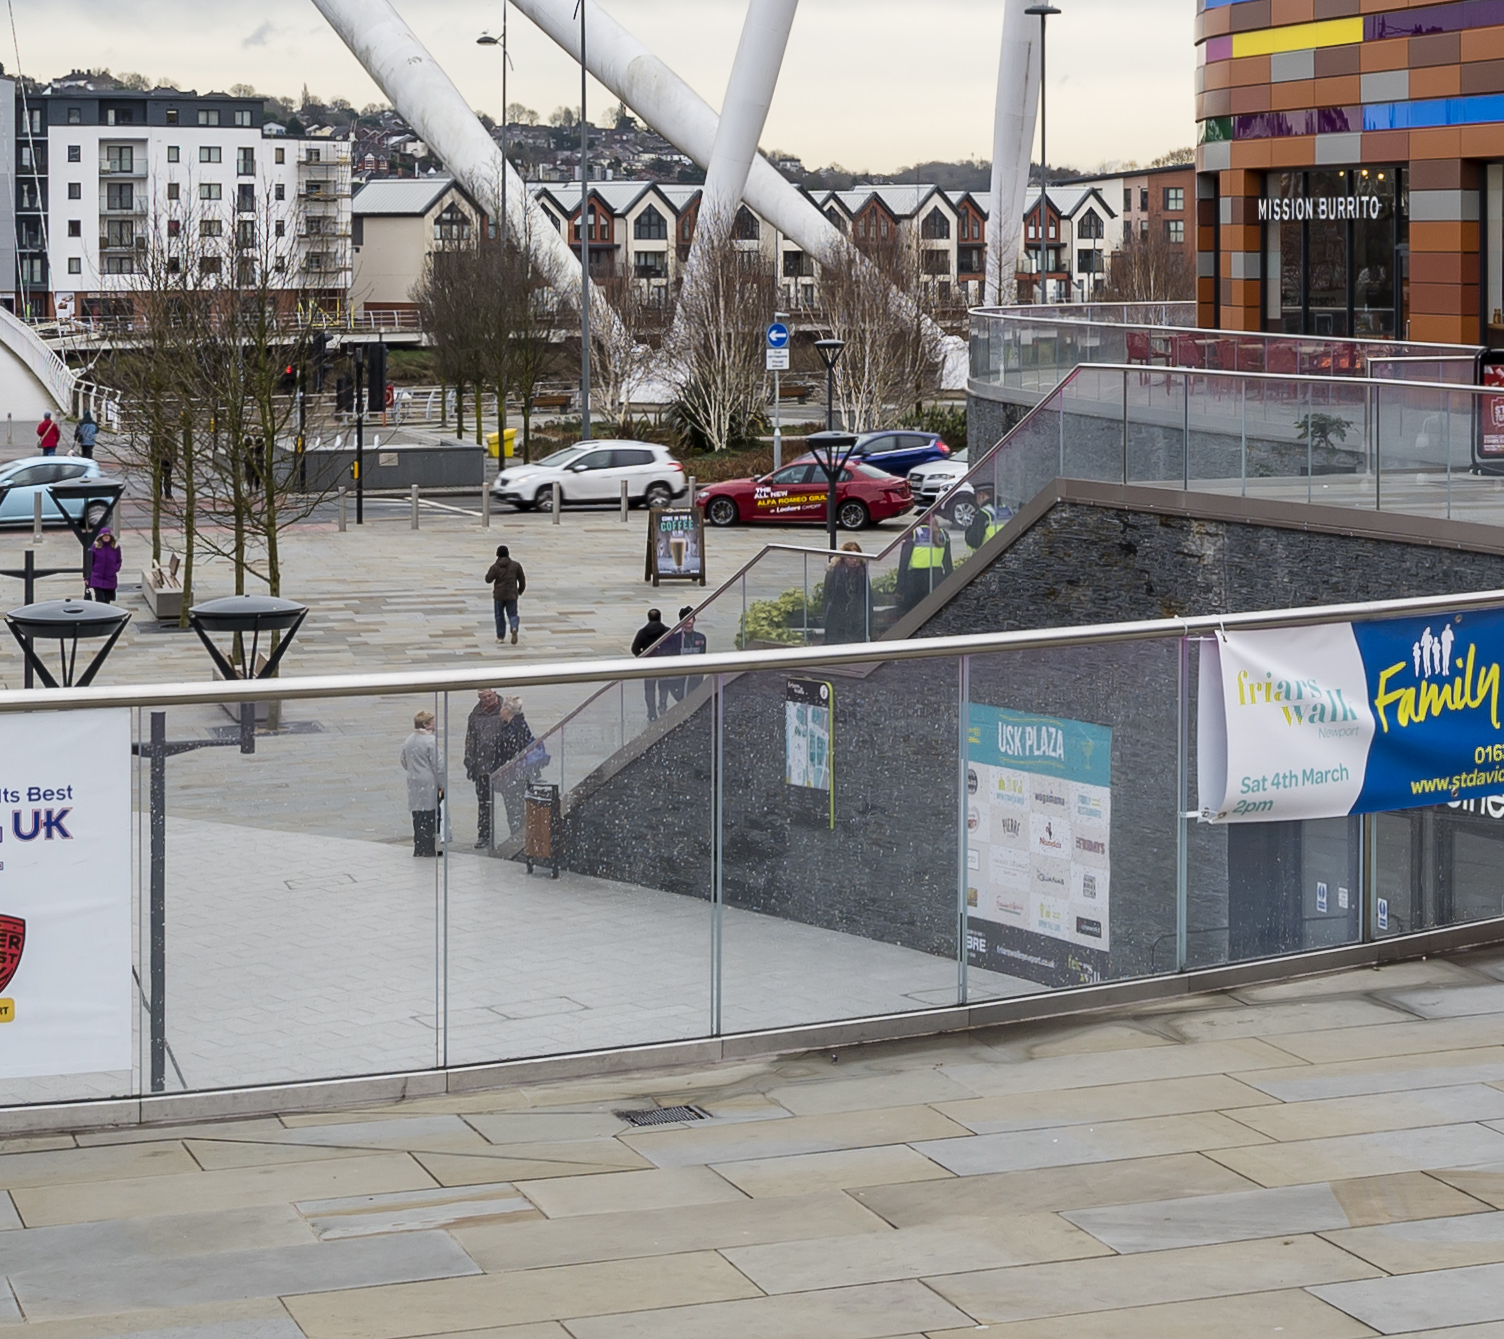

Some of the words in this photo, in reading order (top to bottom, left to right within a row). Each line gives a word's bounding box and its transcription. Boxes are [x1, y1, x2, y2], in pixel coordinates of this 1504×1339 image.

[1258, 198, 1313, 220] MISSION
[1319, 196, 1379, 220] BURRITO
[808, 494, 828, 502] GIUL
[660, 520, 694, 532] COFFEE
[1237, 670, 1323, 706] friars
[1374, 642, 1501, 733] Family
[1282, 688, 1358, 727] walk
[998, 721, 1023, 756] USK
[1025, 725, 1065, 762] PLAZA
[1318, 726, 1360, 739] Newport
[1240, 775, 1268, 795] Sat
[1271, 769, 1299, 790] 4th
[1302, 762, 1349, 787] March
[27, 784, 74, 802] Best
[1232, 798, 1274, 817] 2pm
[12, 806, 74, 842] UK
[967, 935, 987, 953] BRE
